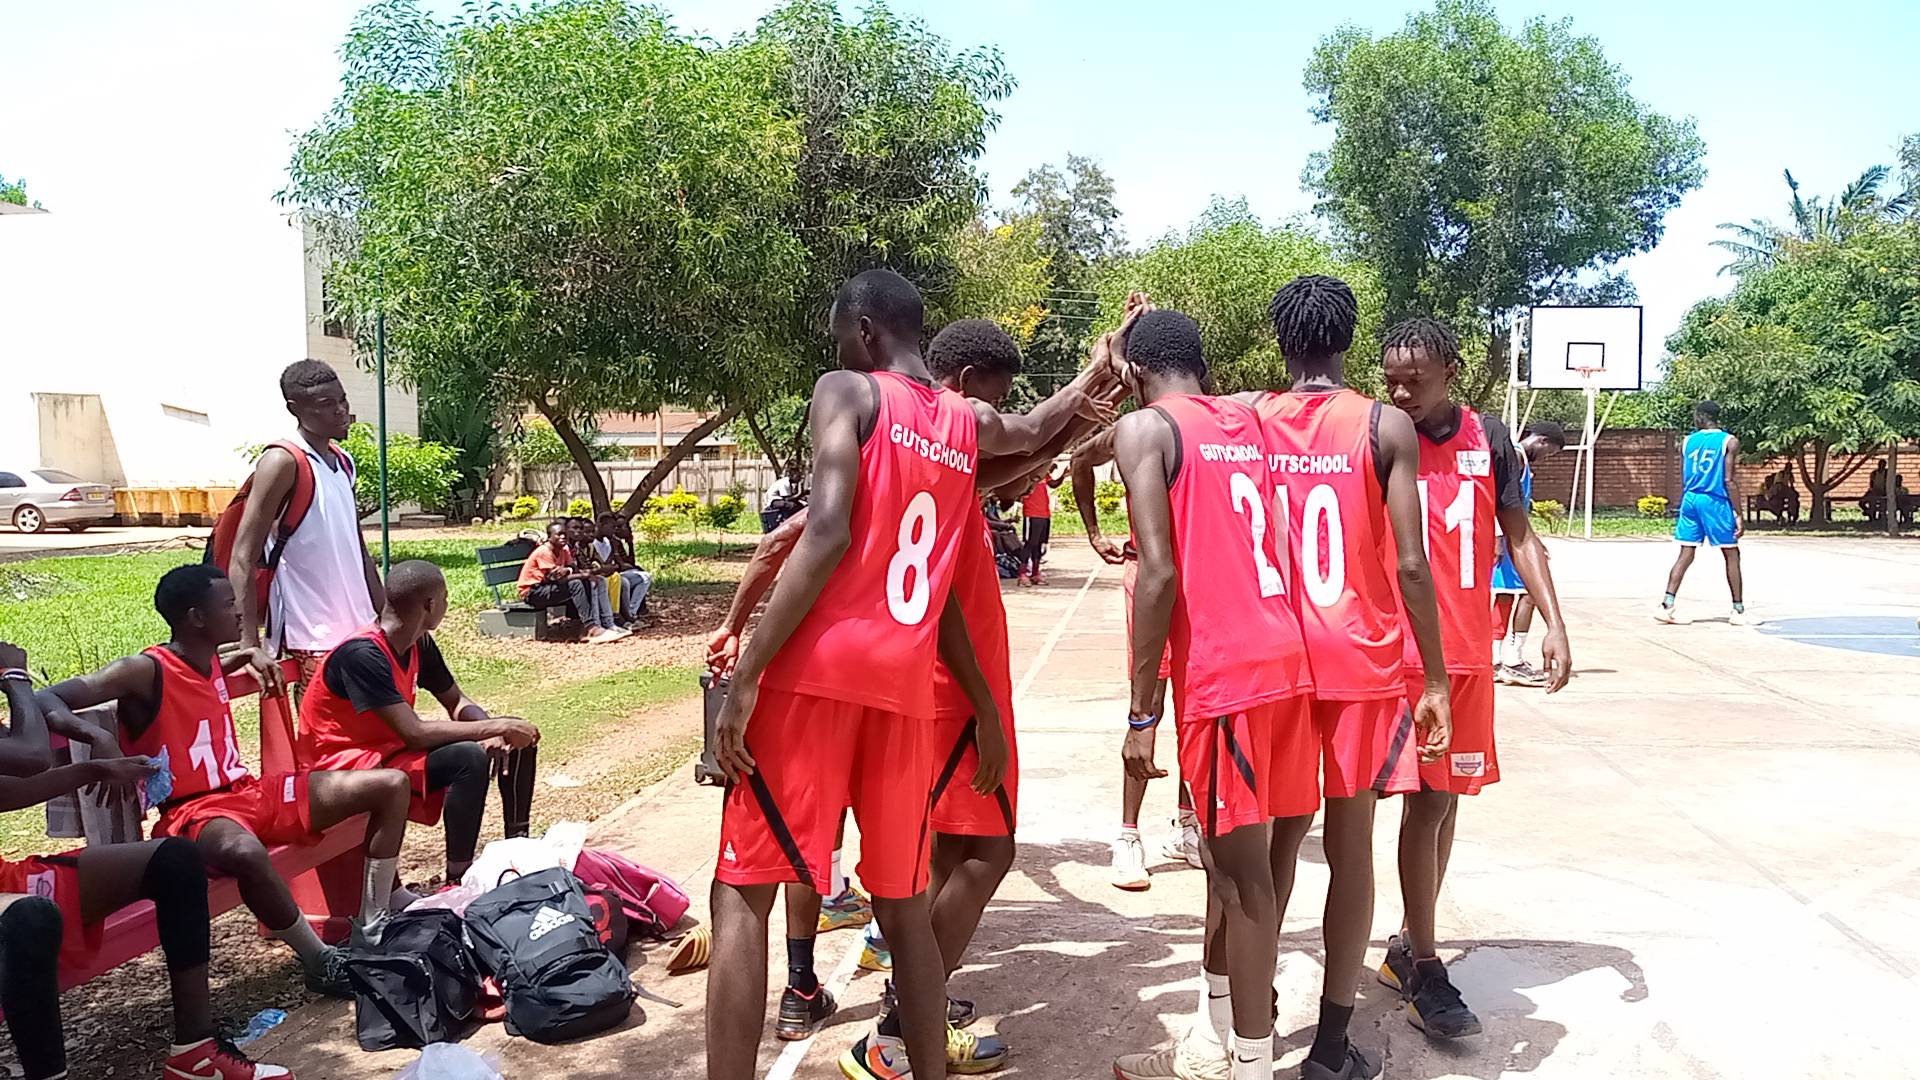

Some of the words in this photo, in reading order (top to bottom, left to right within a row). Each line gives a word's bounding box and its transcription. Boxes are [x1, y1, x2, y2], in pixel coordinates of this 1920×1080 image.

[890, 423, 973, 474] GUTSCHOOL
[1268, 453, 1353, 475] UTSCHOOL
[1687, 448, 1716, 475] 15
[886, 490, 938, 626] 8
